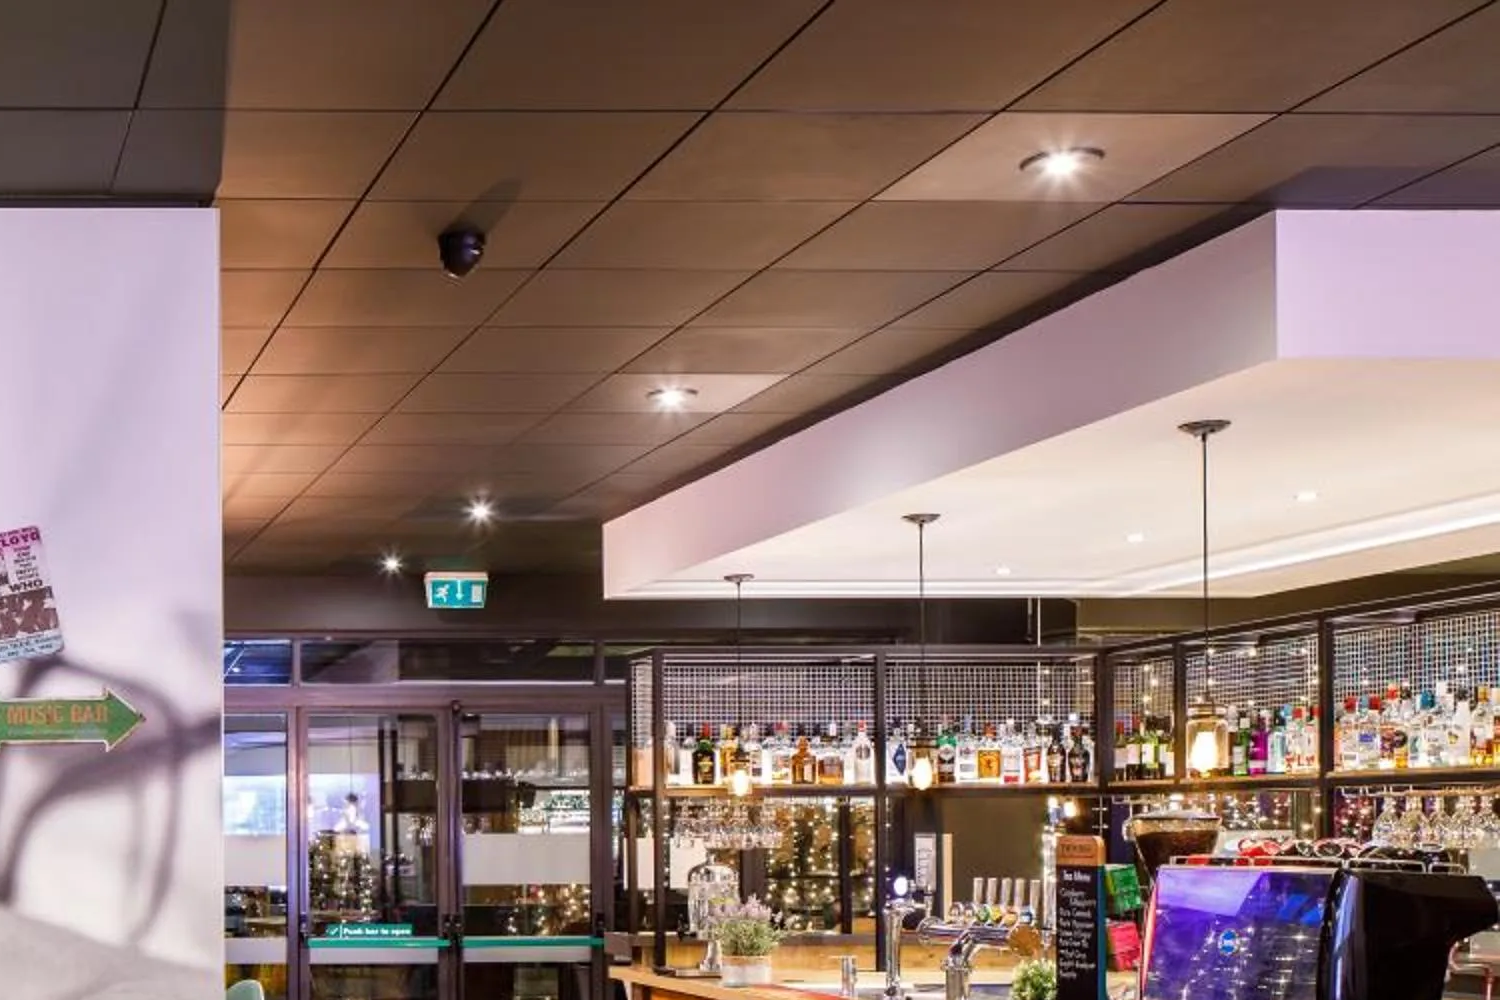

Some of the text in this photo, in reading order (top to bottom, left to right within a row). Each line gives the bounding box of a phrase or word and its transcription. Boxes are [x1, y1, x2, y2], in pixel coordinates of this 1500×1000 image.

[9, 579, 43, 593] WHO
[7, 703, 108, 725] MUSIC BAR
